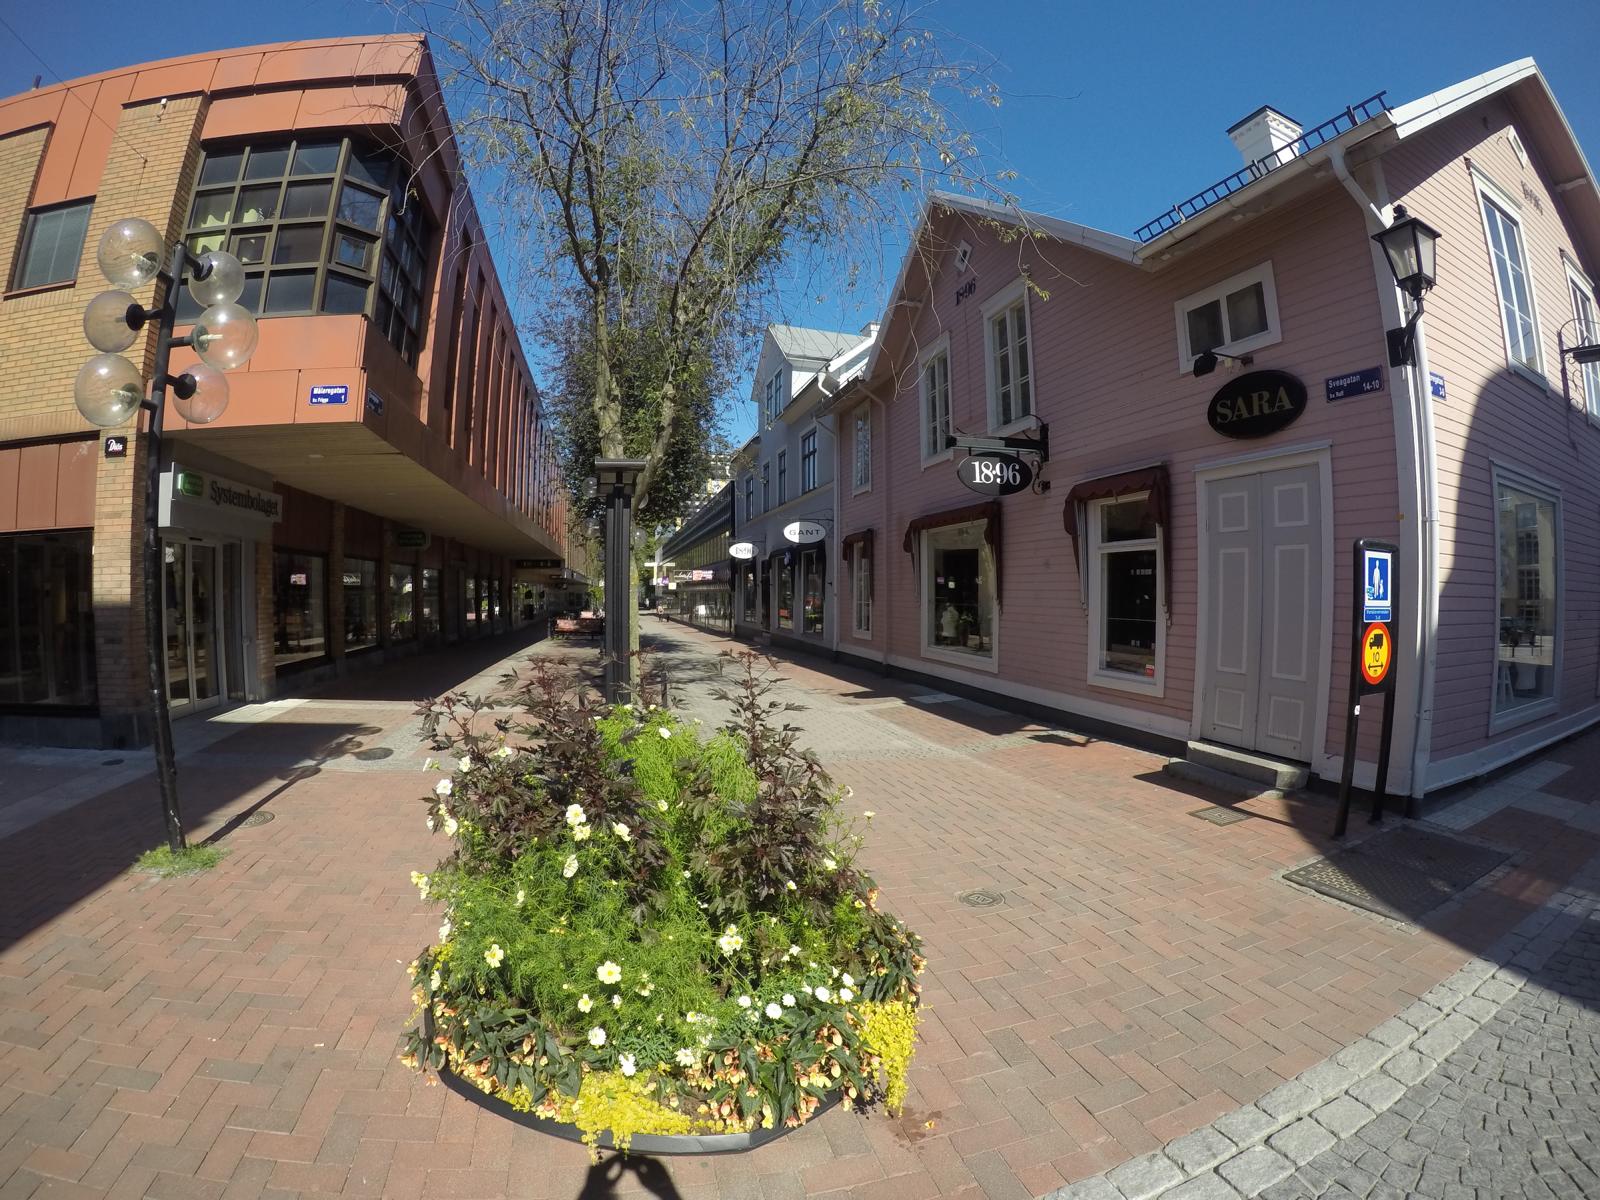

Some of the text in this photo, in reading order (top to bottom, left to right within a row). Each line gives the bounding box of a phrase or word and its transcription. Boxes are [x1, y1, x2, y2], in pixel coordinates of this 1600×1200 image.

[1328, 375, 1361, 389] Sveagatan
[1362, 379, 1380, 391] 14-10
[1216, 386, 1295, 424] SARA
[210, 480, 280, 518] Systembolaget
[788, 528, 822, 537] GANT
[1372, 651, 1381, 663] 10
